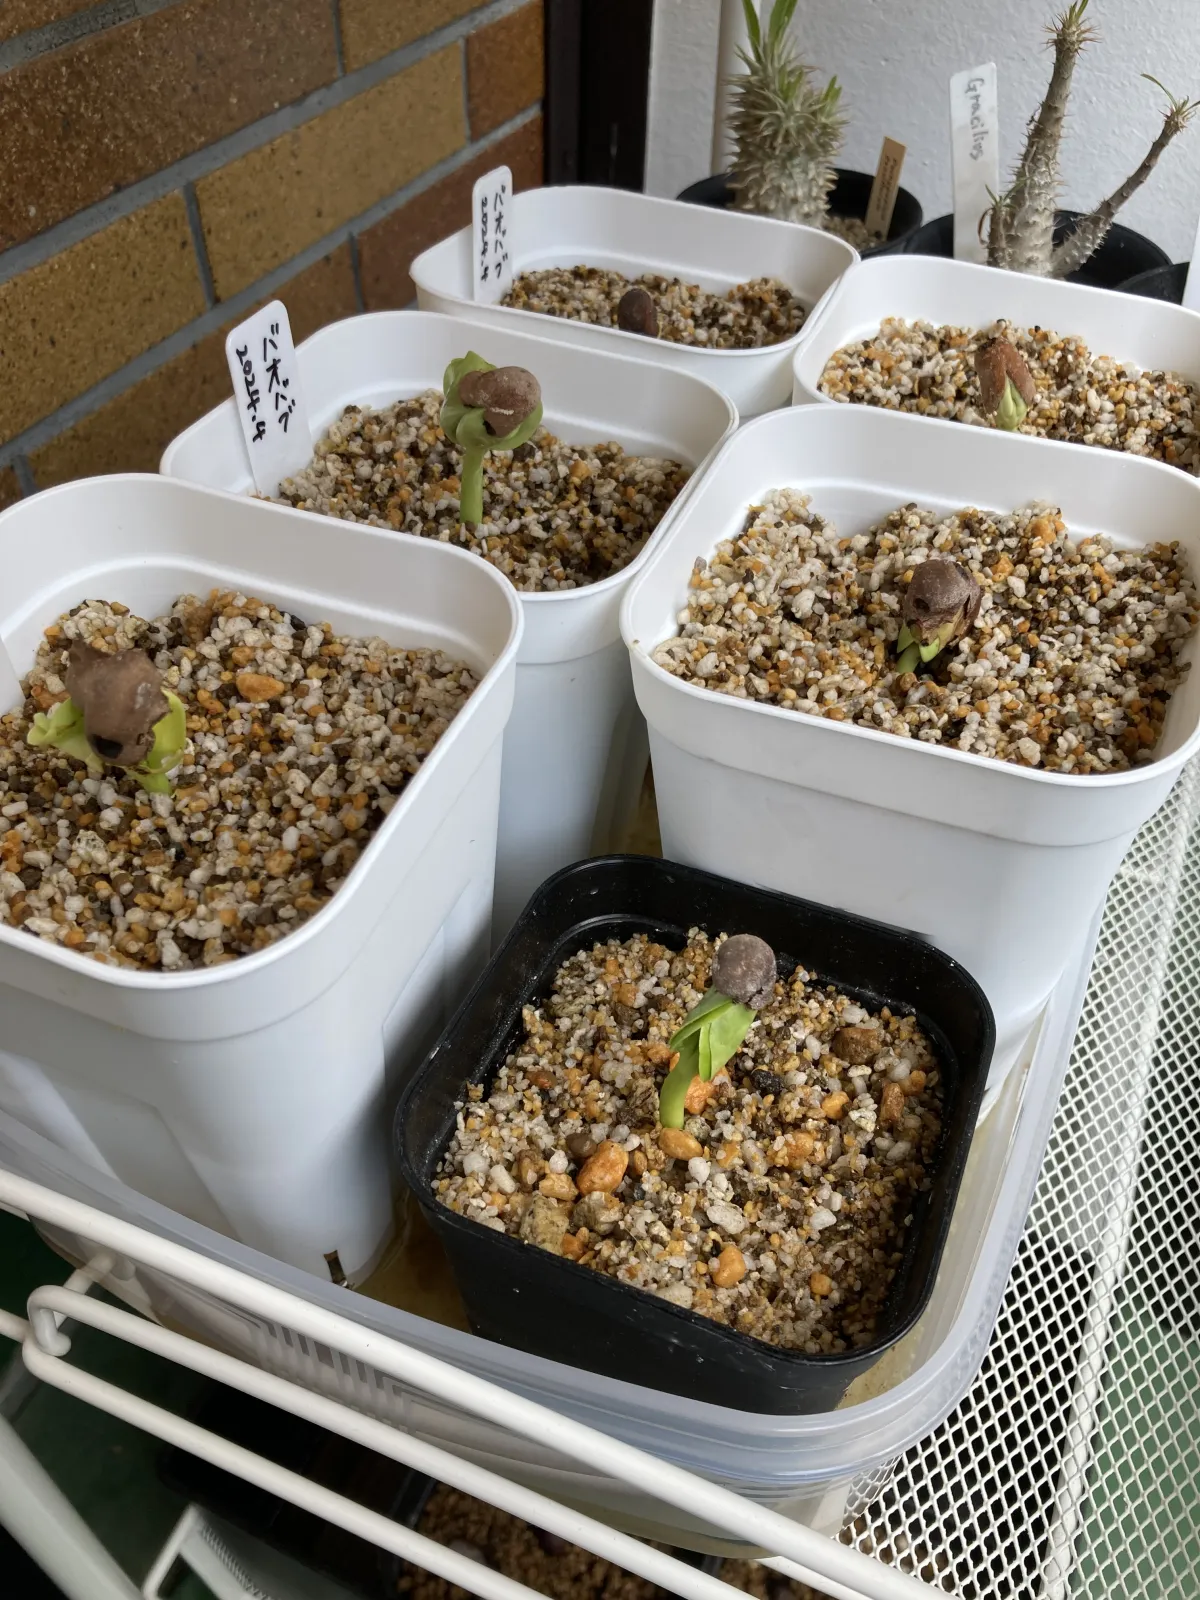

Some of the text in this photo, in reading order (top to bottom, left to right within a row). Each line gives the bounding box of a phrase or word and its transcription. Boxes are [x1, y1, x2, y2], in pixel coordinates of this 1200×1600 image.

[236, 344, 266, 443] 2024.4
[263, 322, 296, 433] バオバブ
